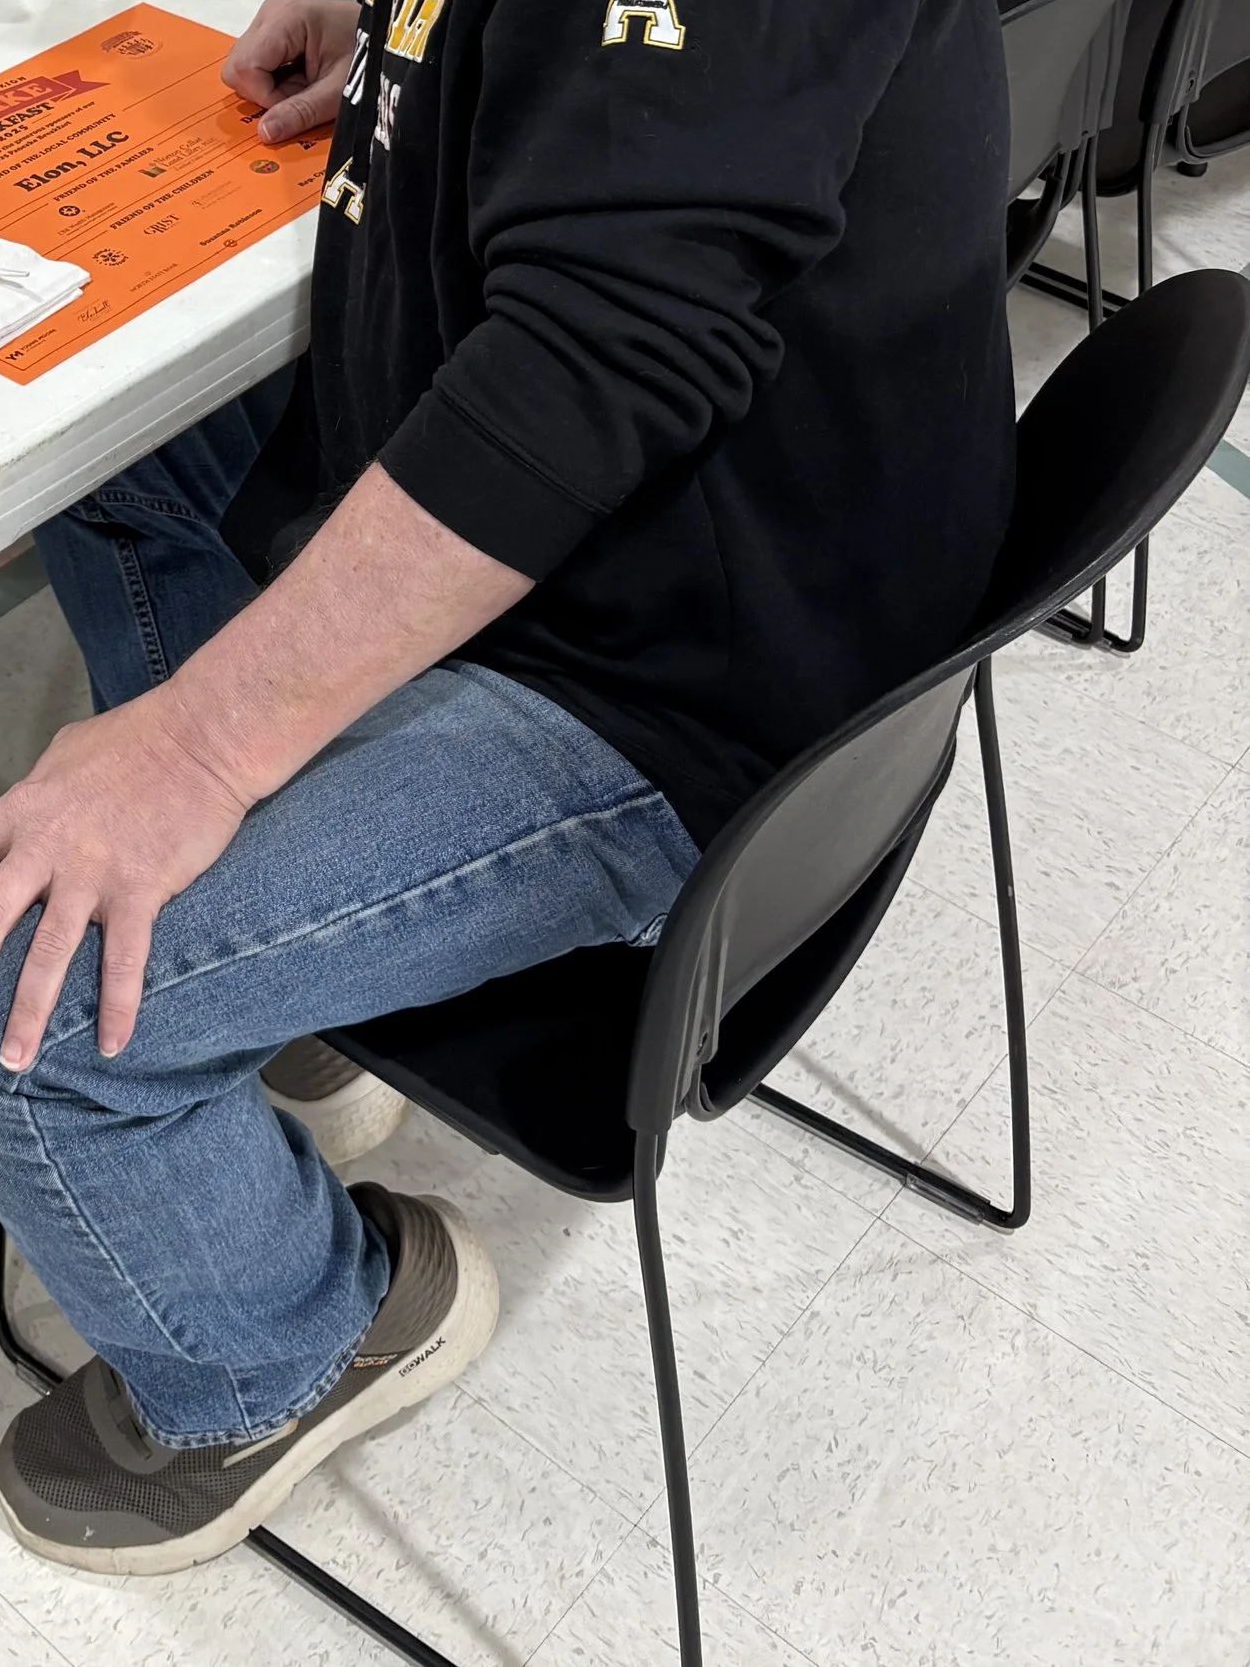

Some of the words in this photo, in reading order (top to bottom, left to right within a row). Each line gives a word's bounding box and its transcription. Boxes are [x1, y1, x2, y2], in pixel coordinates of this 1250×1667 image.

[9, 162, 23, 170] OF
[20, 154, 42, 163] THE
[38, 140, 68, 154] LOCAL
[66, 114, 116, 139] COMMUNITY
[15, 158, 85, 190] Elon,
[75, 130, 131, 158] LLC
[53, 184, 87, 200] FRIEND
[84, 176, 99, 184] OF
[97, 168, 116, 177] THE
[114, 147, 154, 167] FAMILIES
[110, 211, 145, 228] FRIEND
[142, 202, 157, 210] OF
[154, 194, 174, 203] THE
[170, 170, 216, 193] CHILDREN
[141, 214, 185, 236] GRIST
[226, 209, 264, 227] Robinson
